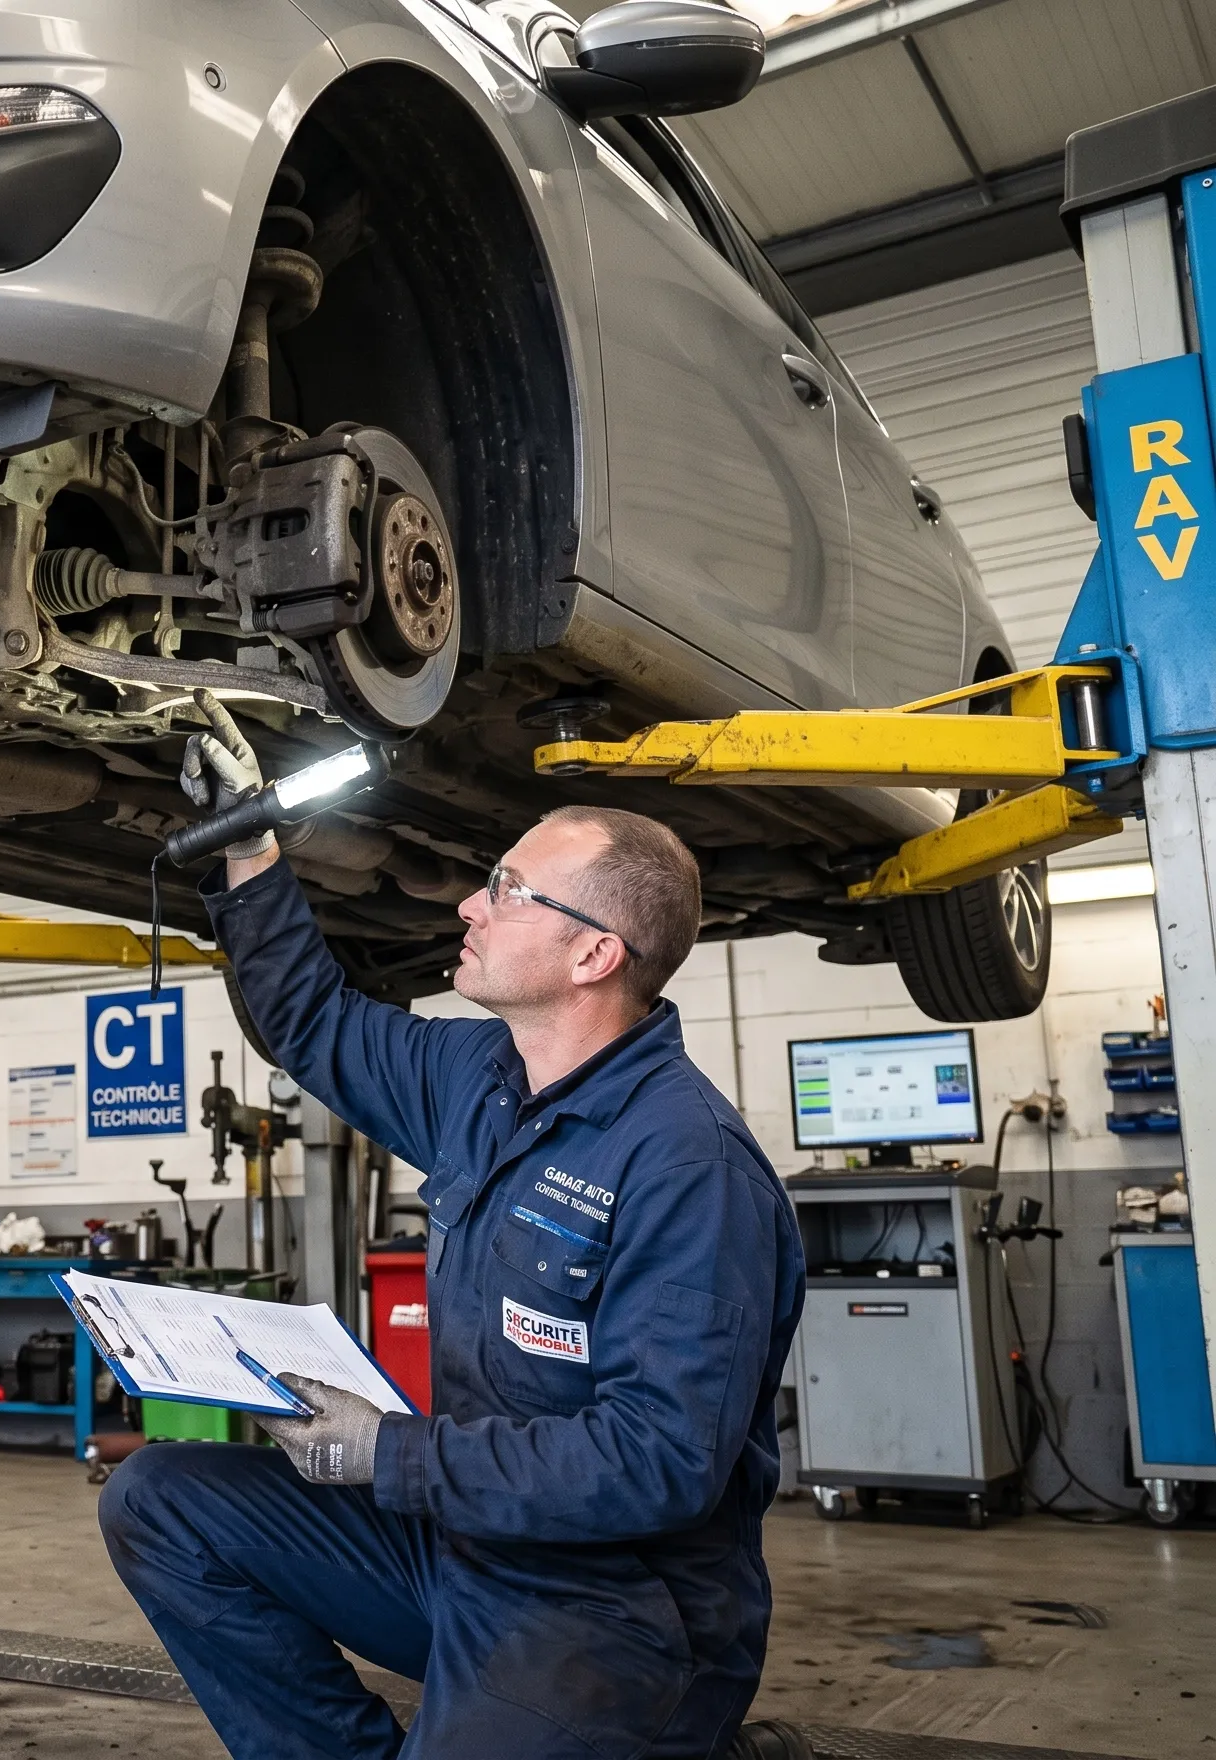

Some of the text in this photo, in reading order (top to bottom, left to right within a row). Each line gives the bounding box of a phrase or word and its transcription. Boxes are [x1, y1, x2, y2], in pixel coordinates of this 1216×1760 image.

[1129, 419, 1200, 580] RAV
[93, 1001, 177, 1069] CT
[92, 1081, 181, 1105] CONTRÔLE
[583, 1184, 615, 1206] AUTO
